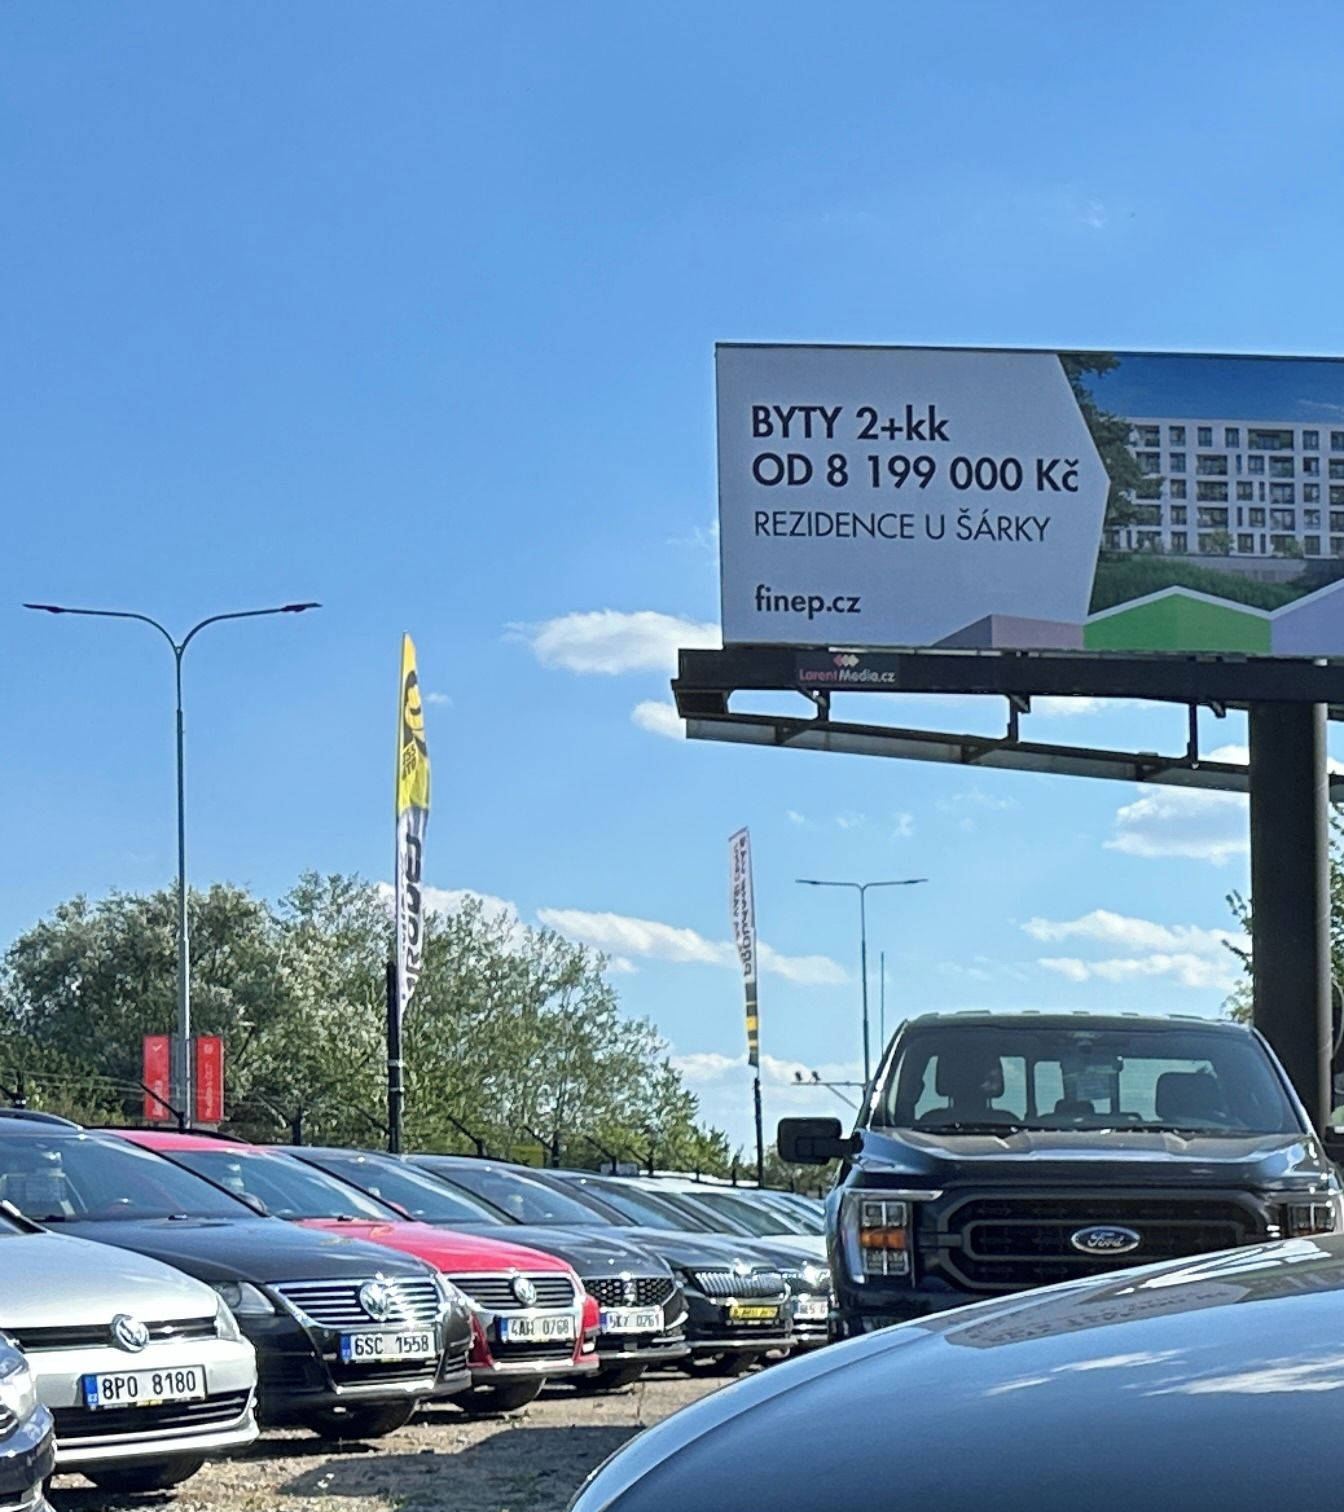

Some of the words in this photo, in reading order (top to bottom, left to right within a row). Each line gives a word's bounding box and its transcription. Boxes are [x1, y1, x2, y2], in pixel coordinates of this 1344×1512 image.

[752, 405, 842, 439] BYTY
[856, 404, 950, 442] 2+kk
[752, 452, 813, 487] OD
[826, 455, 849, 488] 8
[866, 456, 937, 491] 199
[949, 457, 1024, 493] 000
[1036, 455, 1080, 494] Kč
[753, 511, 917, 541] REZIDENCE
[925, 513, 946, 541] U
[956, 506, 1051, 544] ŠÁRKY
[754, 584, 862, 619] finep.cz
[1087, 1232, 1125, 1248] Ford
[355, 1336, 384, 1356] 6SC
[395, 1334, 429, 1354] 1558
[153, 1370, 196, 1395] 8180
